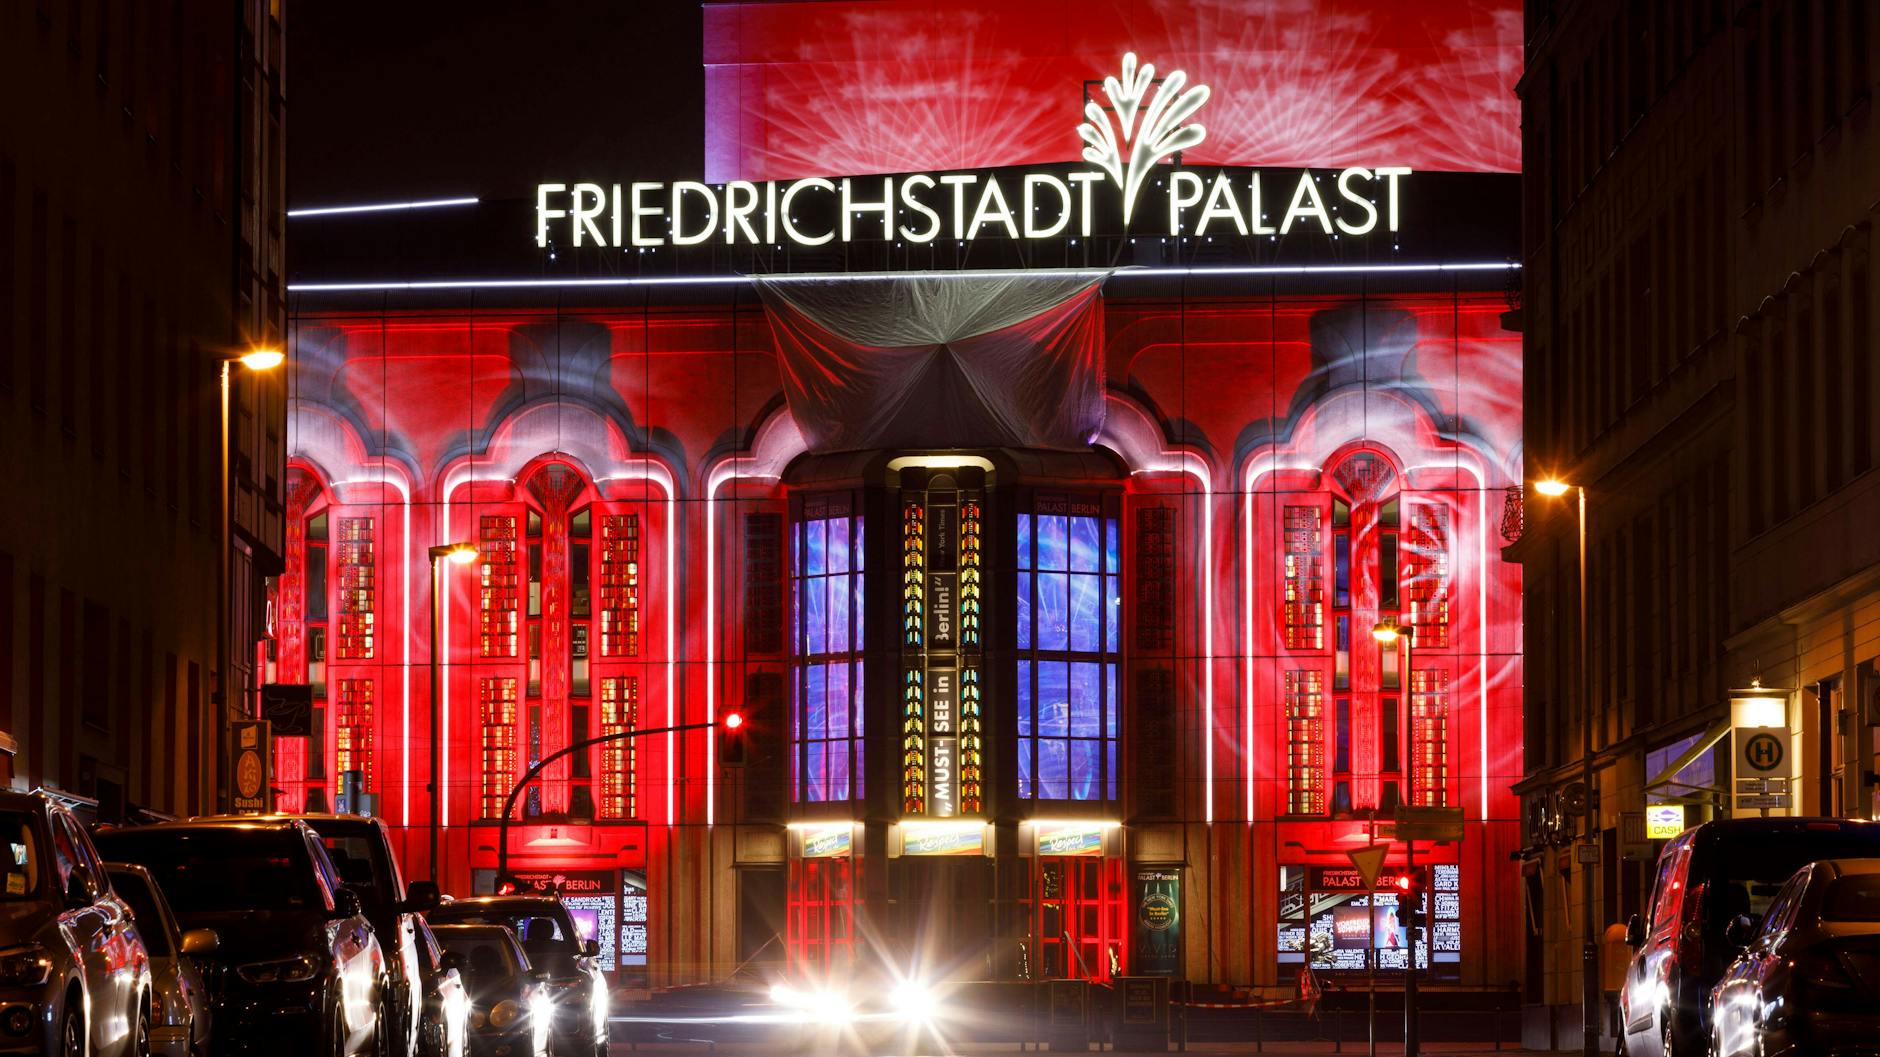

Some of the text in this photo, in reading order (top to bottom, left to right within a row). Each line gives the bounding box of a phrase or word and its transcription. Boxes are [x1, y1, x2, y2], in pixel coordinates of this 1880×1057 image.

[537, 166, 1413, 248] FRIEDRICHSTADT PALAST
[1037, 502, 1100, 514] PALAST BERLIN
[933, 676, 949, 693] in
[1755, 742, 1773, 762] H
[234, 797, 265, 808] Sushi
[1653, 826, 1682, 835] CASH
[1049, 832, 1085, 853] Respect
[565, 879, 602, 890] BERLIN
[1322, 876, 1361, 887] PALAST
